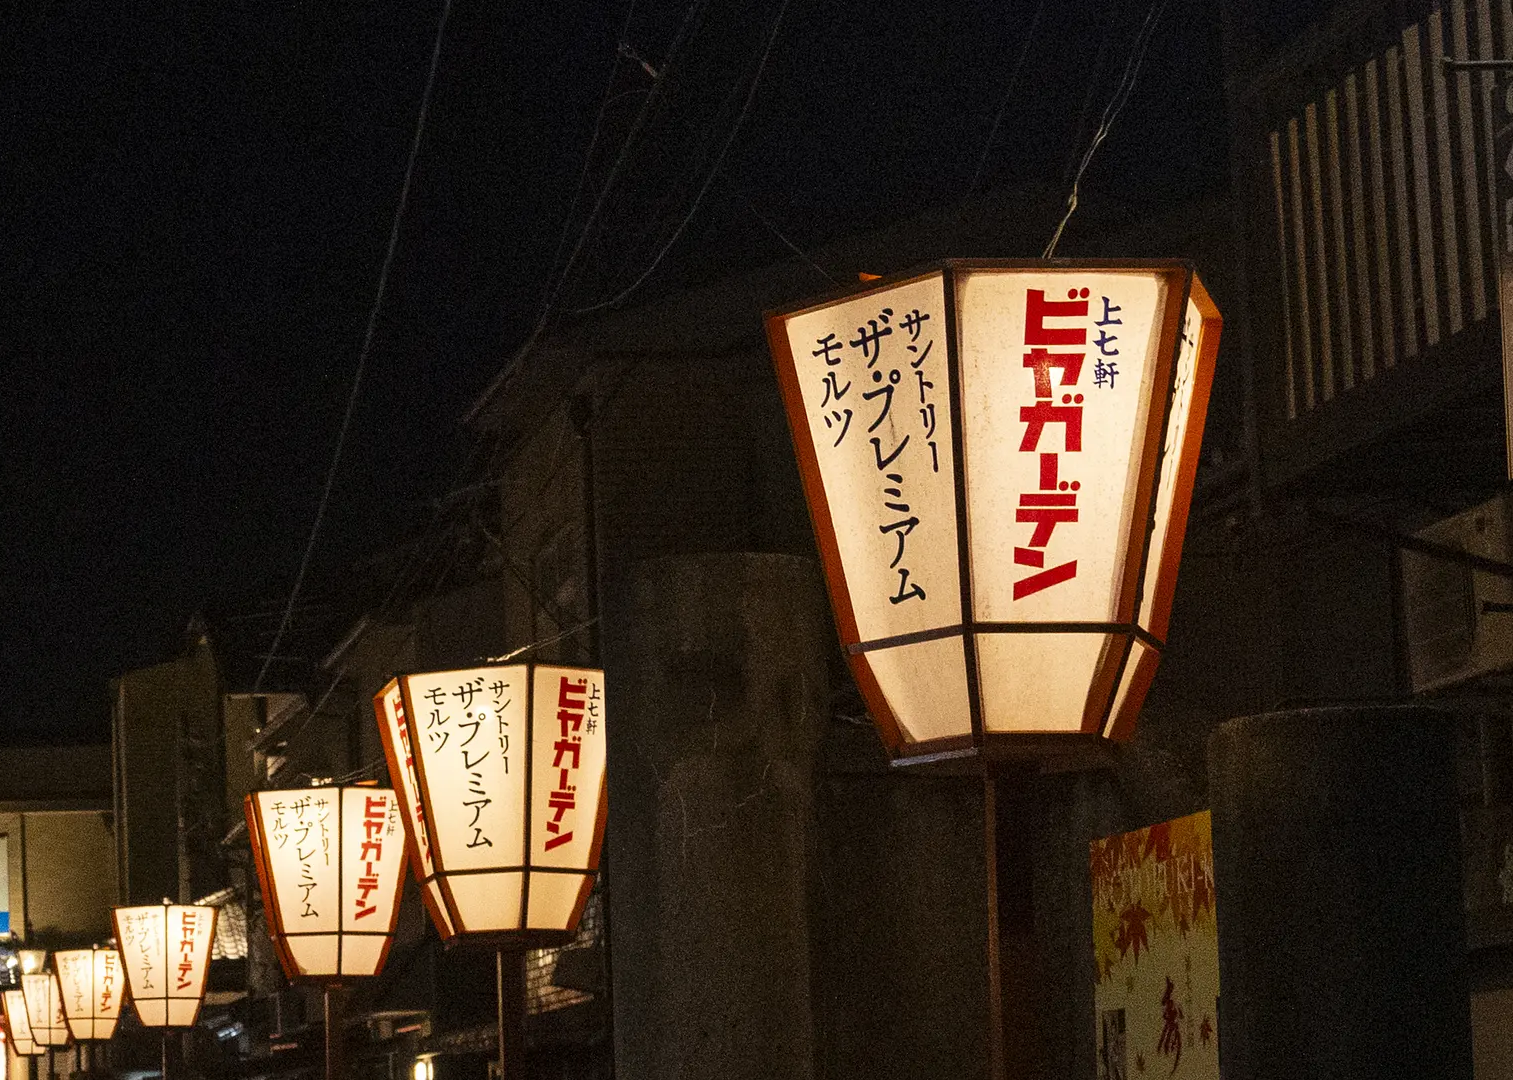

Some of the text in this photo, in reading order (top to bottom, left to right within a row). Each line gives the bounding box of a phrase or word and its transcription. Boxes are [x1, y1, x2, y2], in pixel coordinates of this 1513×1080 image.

[811, 332, 854, 448] モルツ
[898, 308, 940, 473] サントリー
[1091, 295, 1123, 390] 上七軒
[848, 307, 927, 606] ザ・プレミアム
[1011, 286, 1091, 603] ビヤガーデン
[423, 686, 452, 754] モルツ
[451, 676, 494, 850] ザ・プレミアム
[488, 680, 512, 775] サントリー
[544, 676, 589, 852] ビヤガーデン
[585, 683, 601, 735] 上七軒
[269, 799, 290, 850] モルツ
[289, 795, 320, 919] ザ・プレミアム
[313, 797, 330, 867] サントリー
[354, 795, 388, 921] ビヤガーデン
